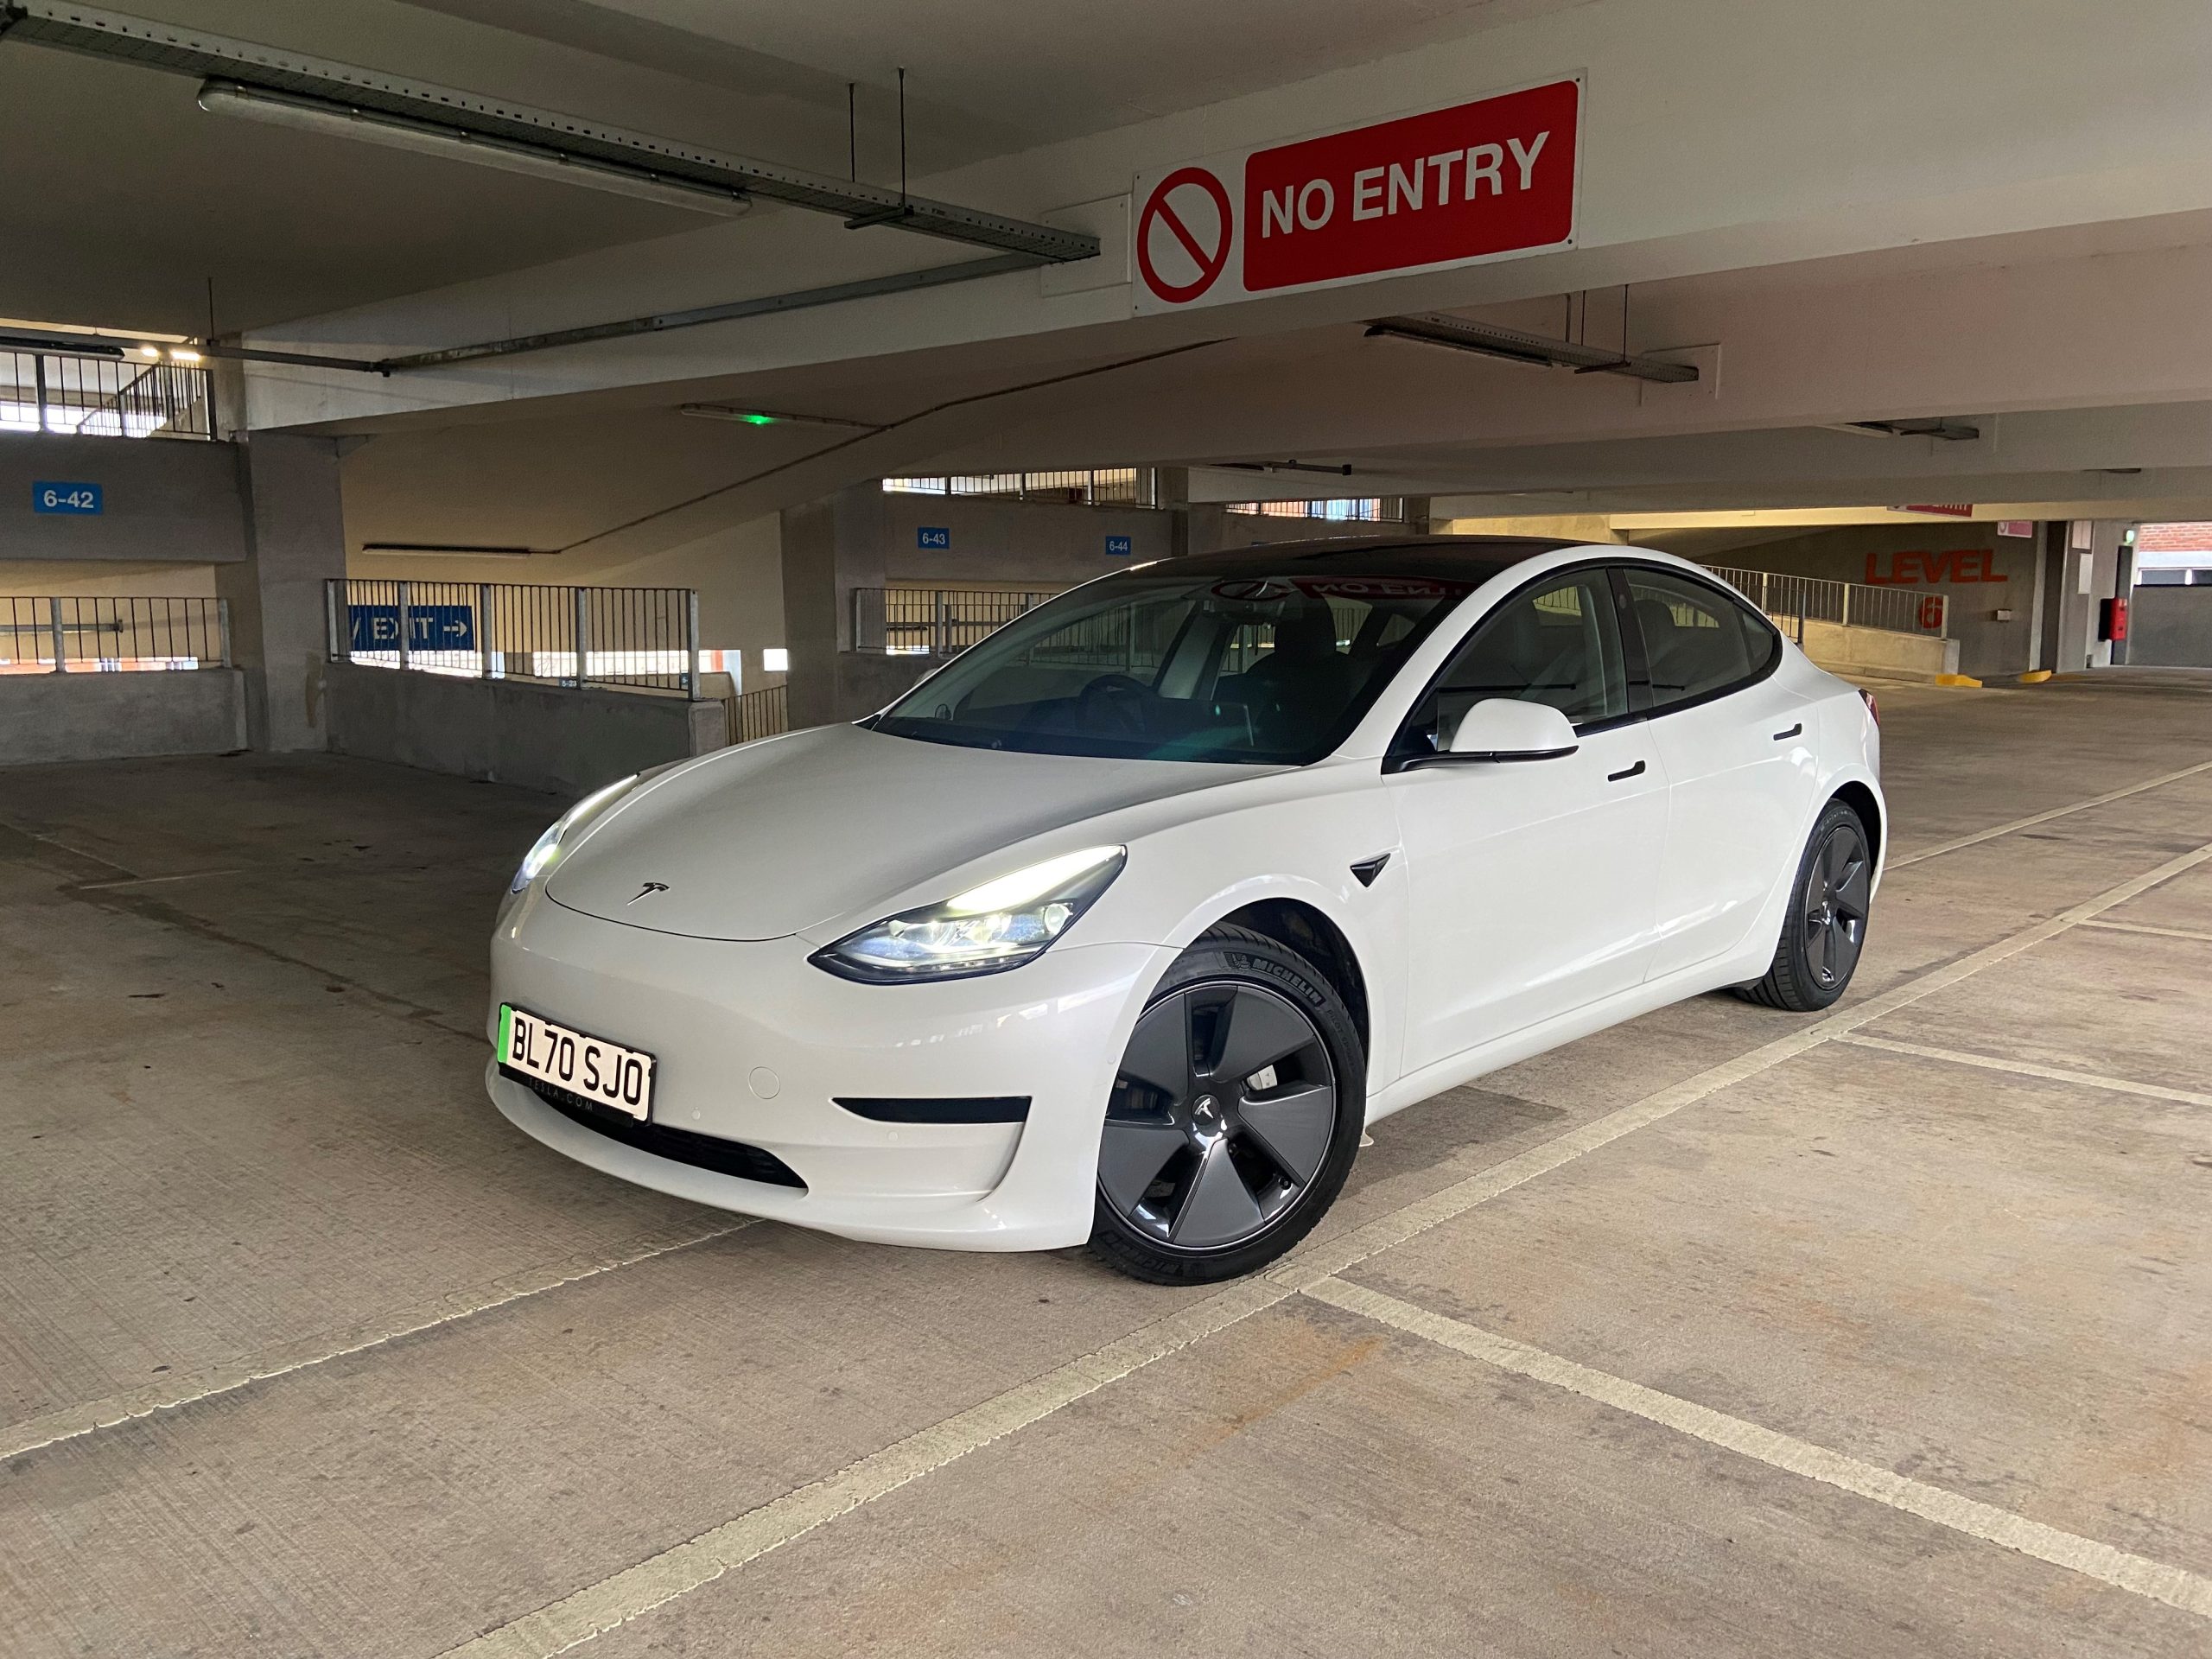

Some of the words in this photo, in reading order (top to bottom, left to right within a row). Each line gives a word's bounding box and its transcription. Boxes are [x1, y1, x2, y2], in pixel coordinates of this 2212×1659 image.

[1262, 179, 1335, 238] NO
[1353, 130, 1551, 221] ENTRY
[43, 489, 94, 509] 6-42
[922, 532, 946, 545] 6-43
[1109, 540, 1128, 552] 6-44
[1865, 549, 2008, 585] LEVEL
[1918, 596, 1944, 629] 6
[1252, 958, 1323, 1004] MICHELIN
[512, 1017, 575, 1082] BL70
